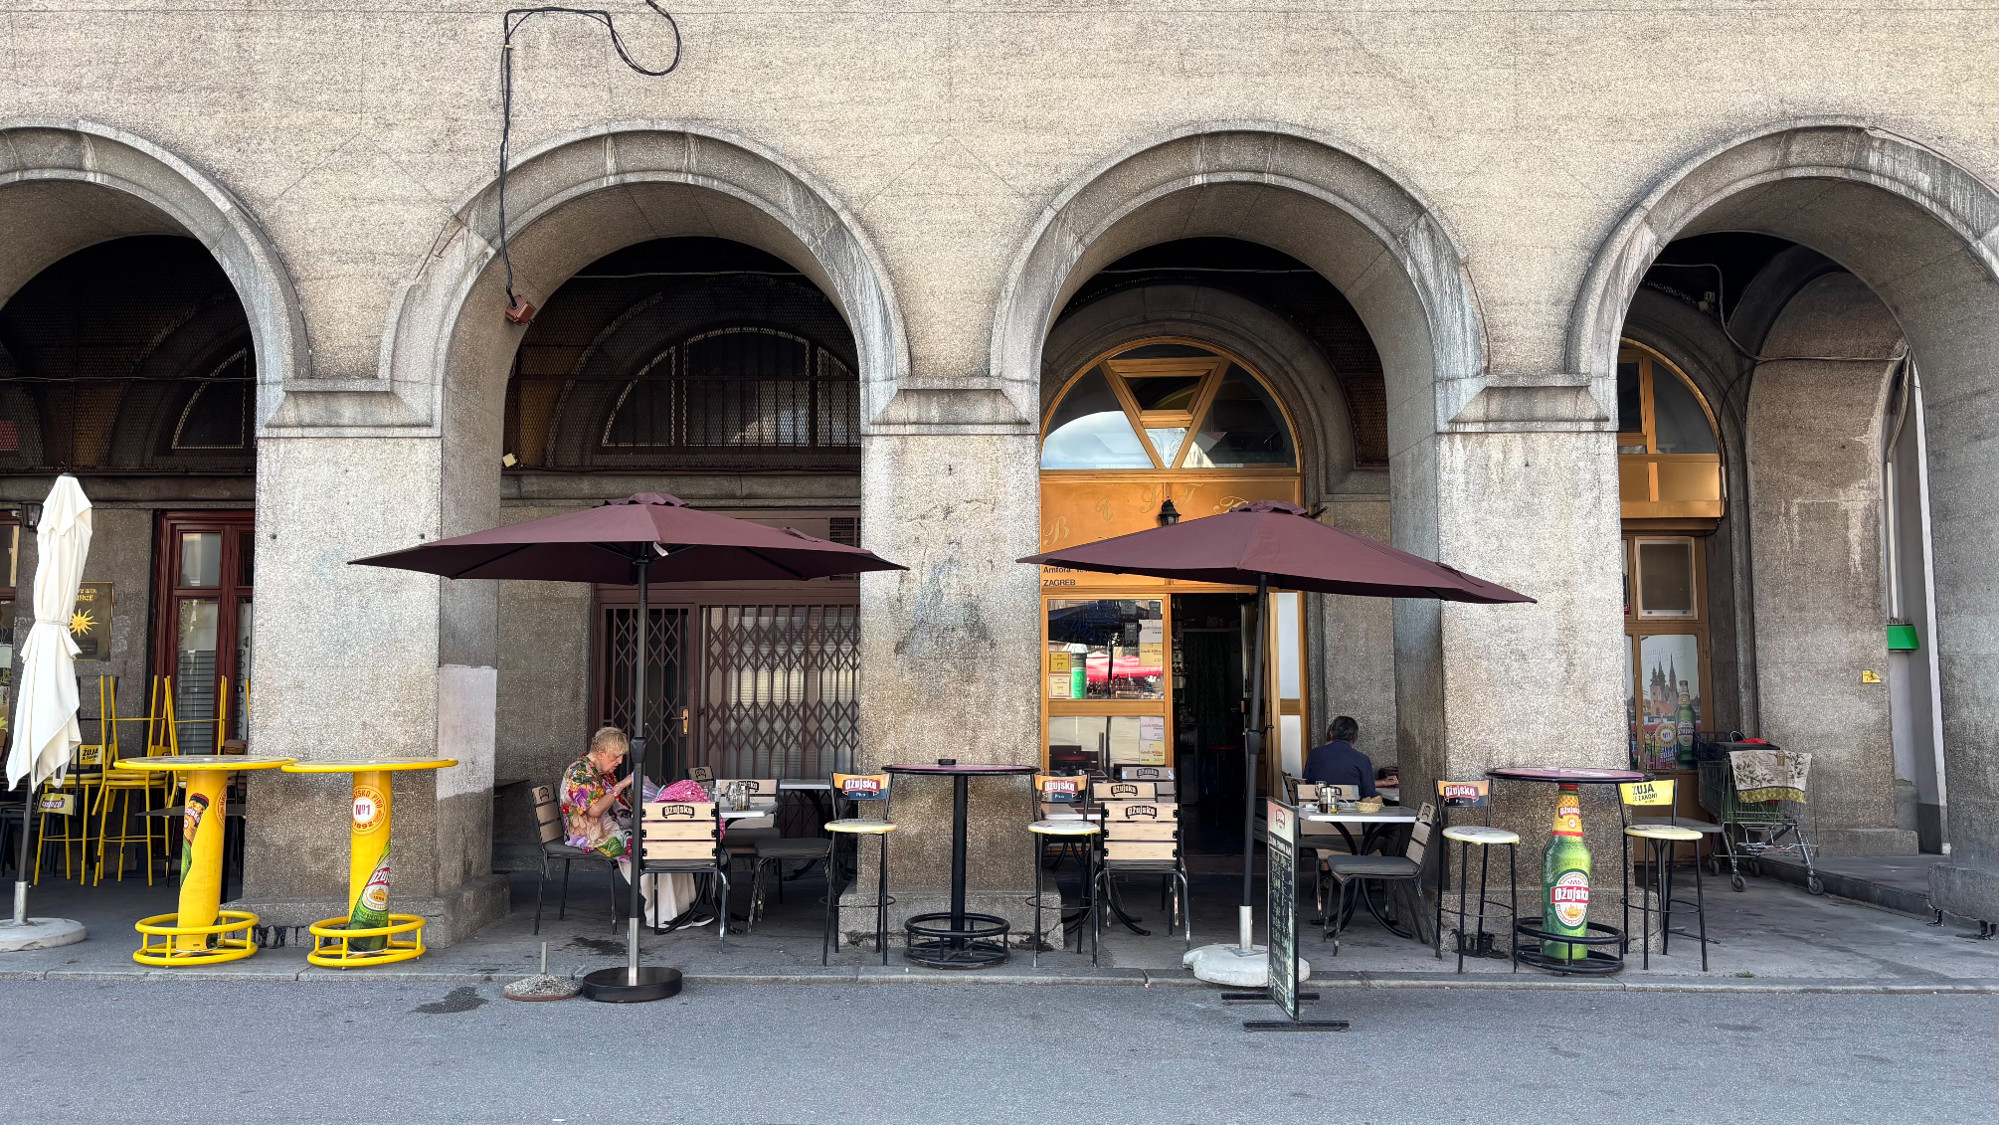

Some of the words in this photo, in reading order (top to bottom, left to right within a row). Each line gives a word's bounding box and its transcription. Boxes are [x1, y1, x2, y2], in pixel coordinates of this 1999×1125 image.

[845, 779, 877, 790] Ožujsko
[1044, 780, 1075, 791] Ožujsko
[1112, 785, 1137, 794] Ožujsko
[1445, 786, 1476, 797] Ožujsko
[371, 794, 384, 809] PIVO
[664, 805, 693, 816] Ožujsko
[1127, 806, 1157, 816] Ožujsko
